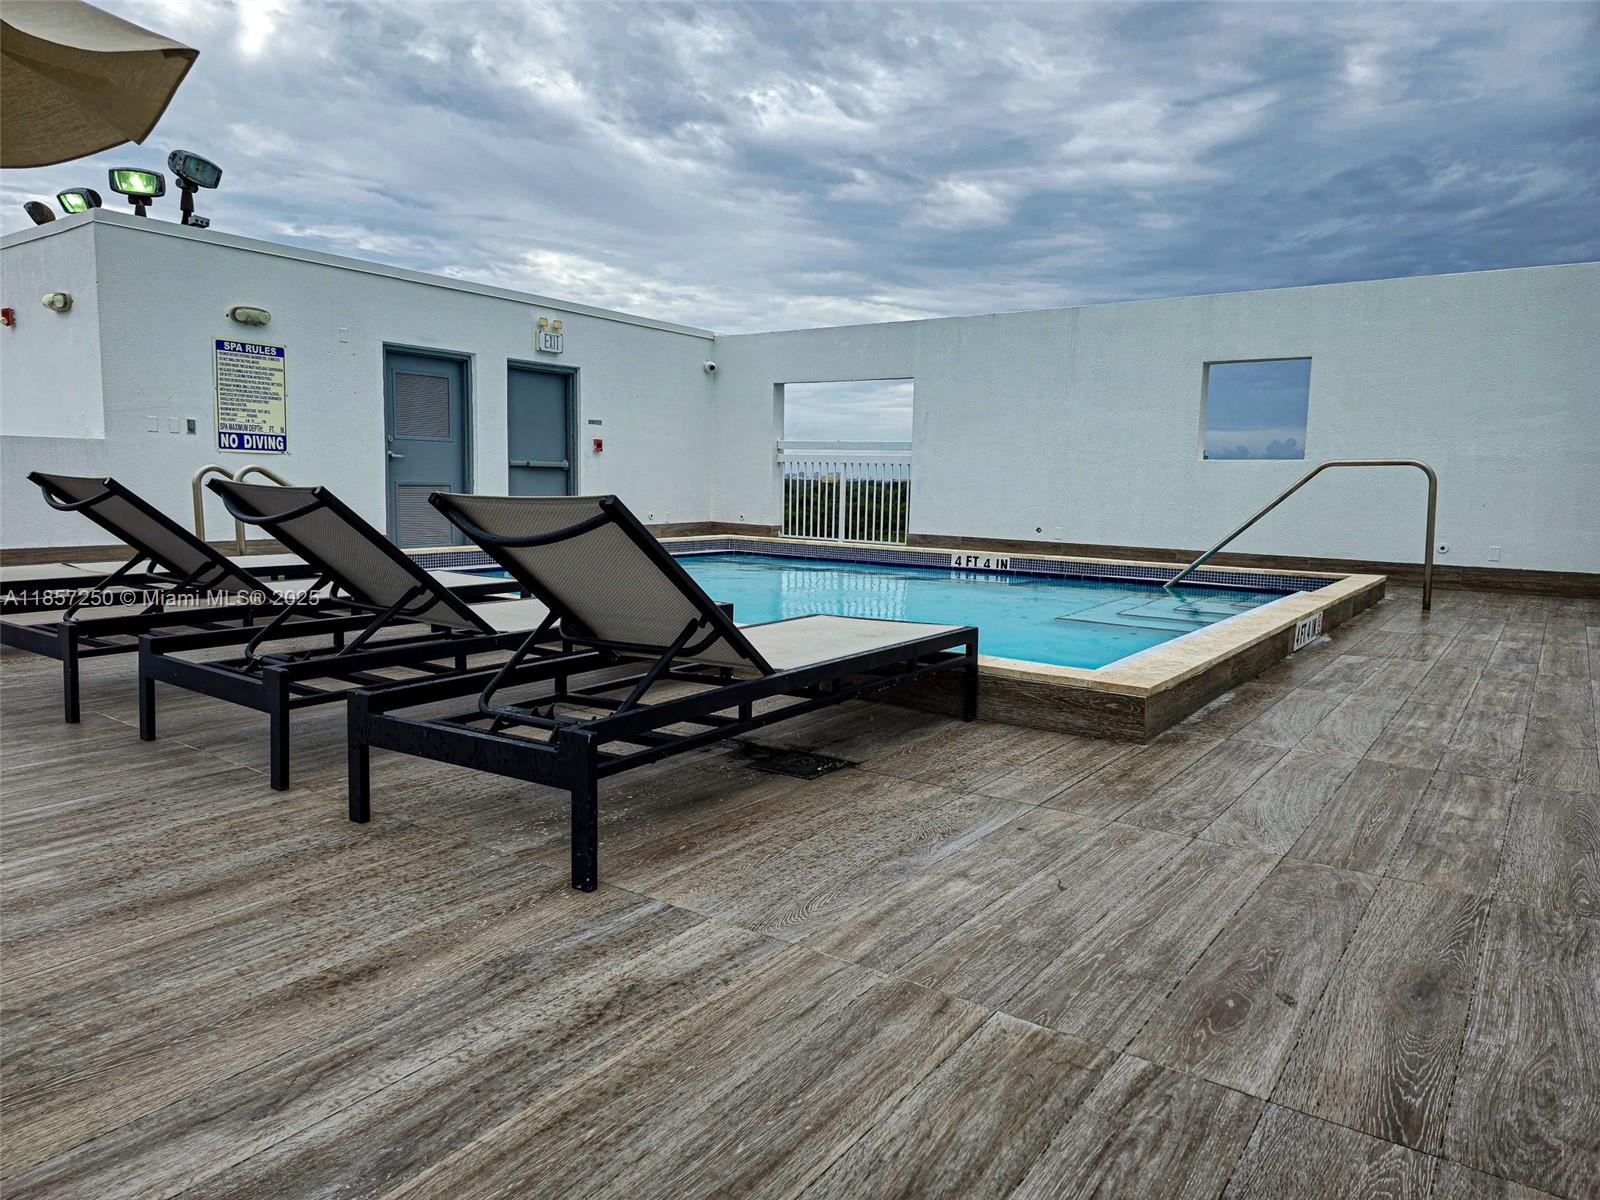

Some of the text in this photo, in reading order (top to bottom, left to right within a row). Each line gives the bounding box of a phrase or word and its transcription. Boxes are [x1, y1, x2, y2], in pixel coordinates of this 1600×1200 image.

[223, 341, 277, 356] SPA RULES
[544, 333, 560, 351] EXIT
[220, 422, 228, 431] SPA
[220, 433, 285, 450] NO DIVING
[954, 555, 1009, 570] 4 FT 4 IN
[1300, 622, 1307, 645] FT
